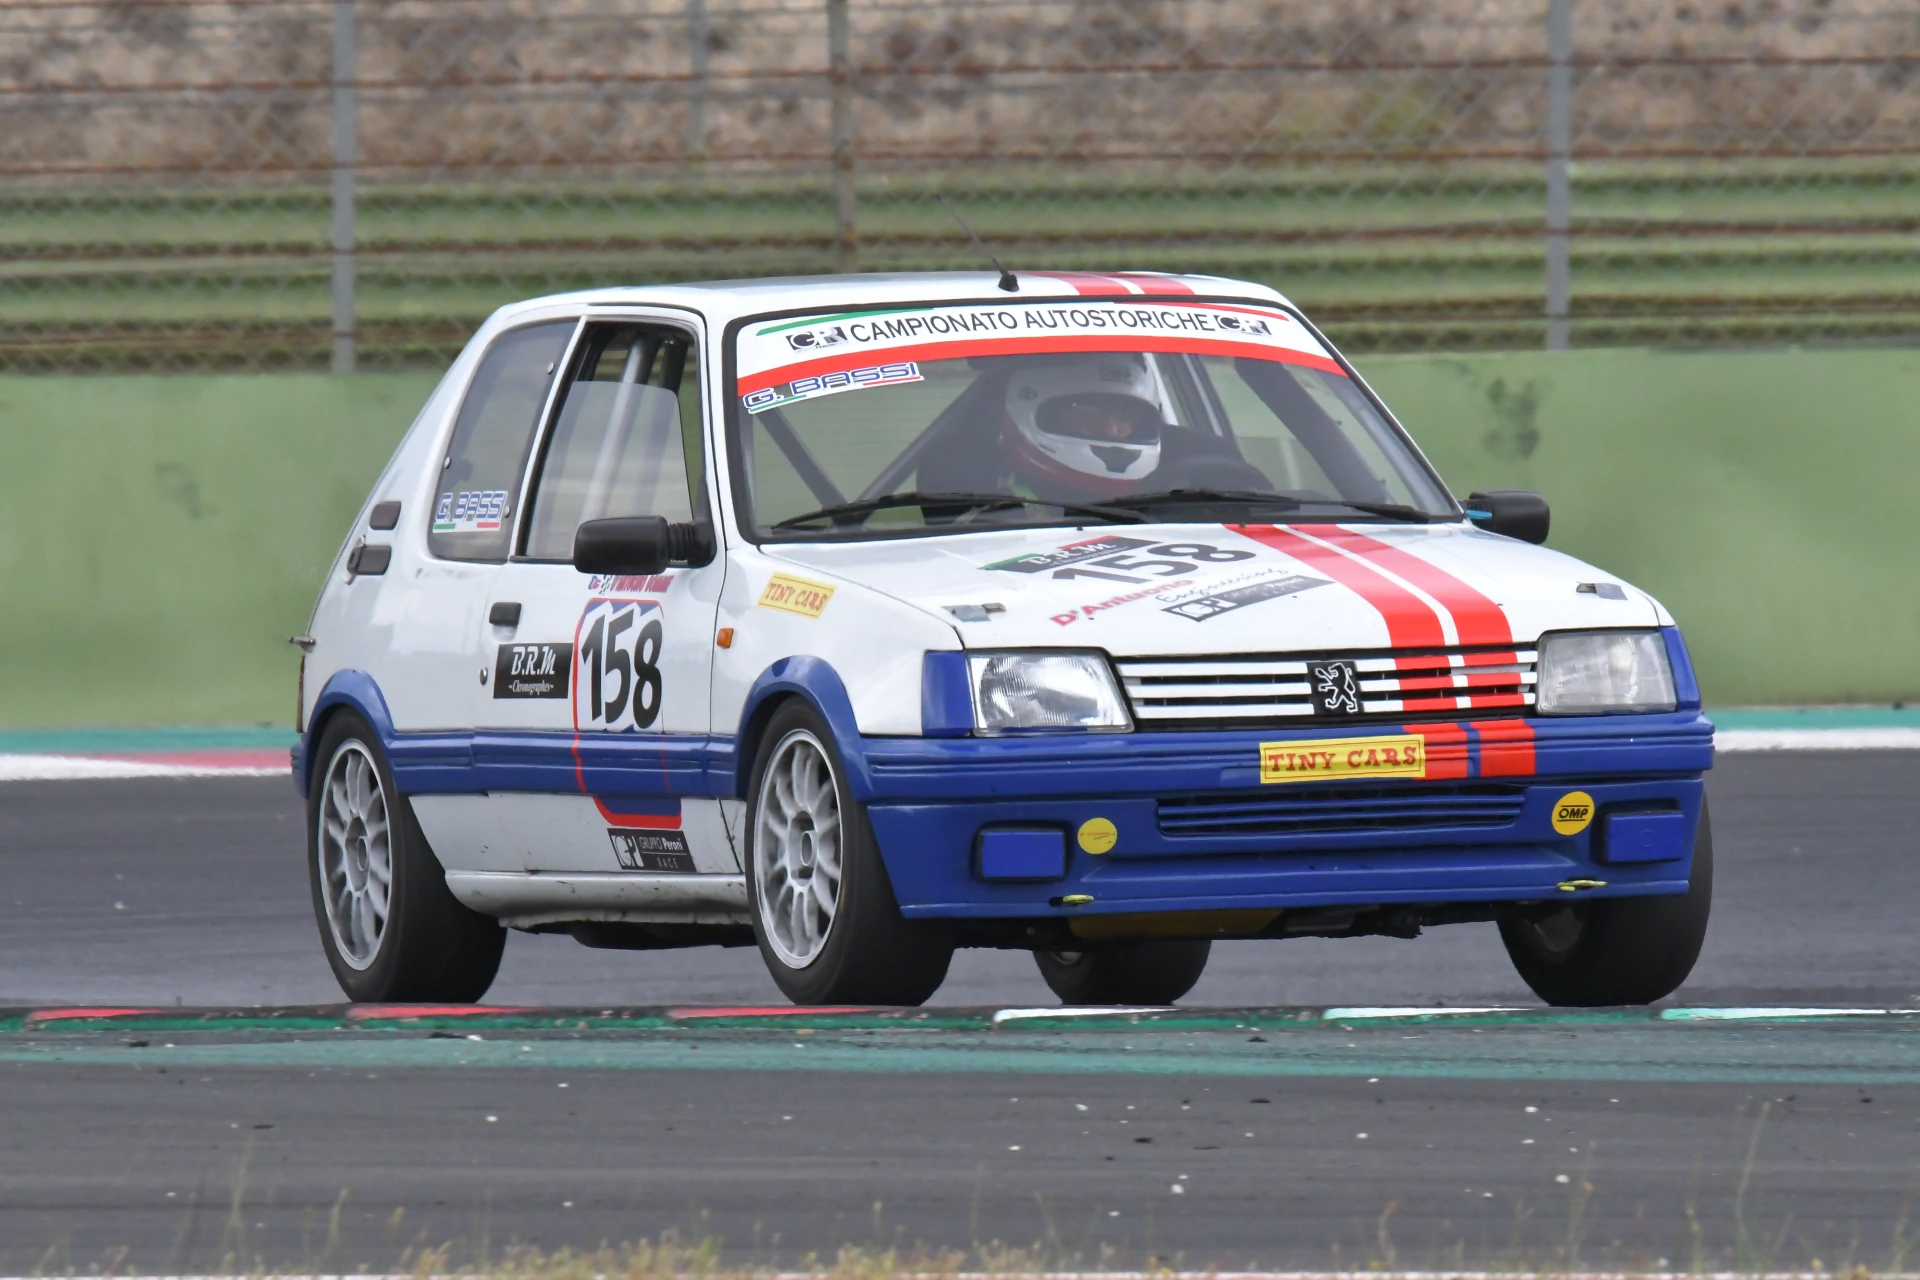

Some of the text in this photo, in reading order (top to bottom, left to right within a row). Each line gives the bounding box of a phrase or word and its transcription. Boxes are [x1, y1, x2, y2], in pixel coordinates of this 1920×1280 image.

[850, 311, 1018, 343] CAMPIONATO
[1024, 309, 1216, 332] AUTOSTORICHE
[744, 362, 917, 409] G. BASSI
[453, 491, 508, 521] BASSI
[1052, 543, 1256, 585] 158
[765, 582, 828, 611] TINY CARS
[1050, 579, 1194, 626] D'Antuono
[581, 608, 663, 730] 158
[1268, 745, 1417, 772] TINY CARS
[1558, 807, 1589, 819] OMP
[661, 837, 684, 851] Peroni
